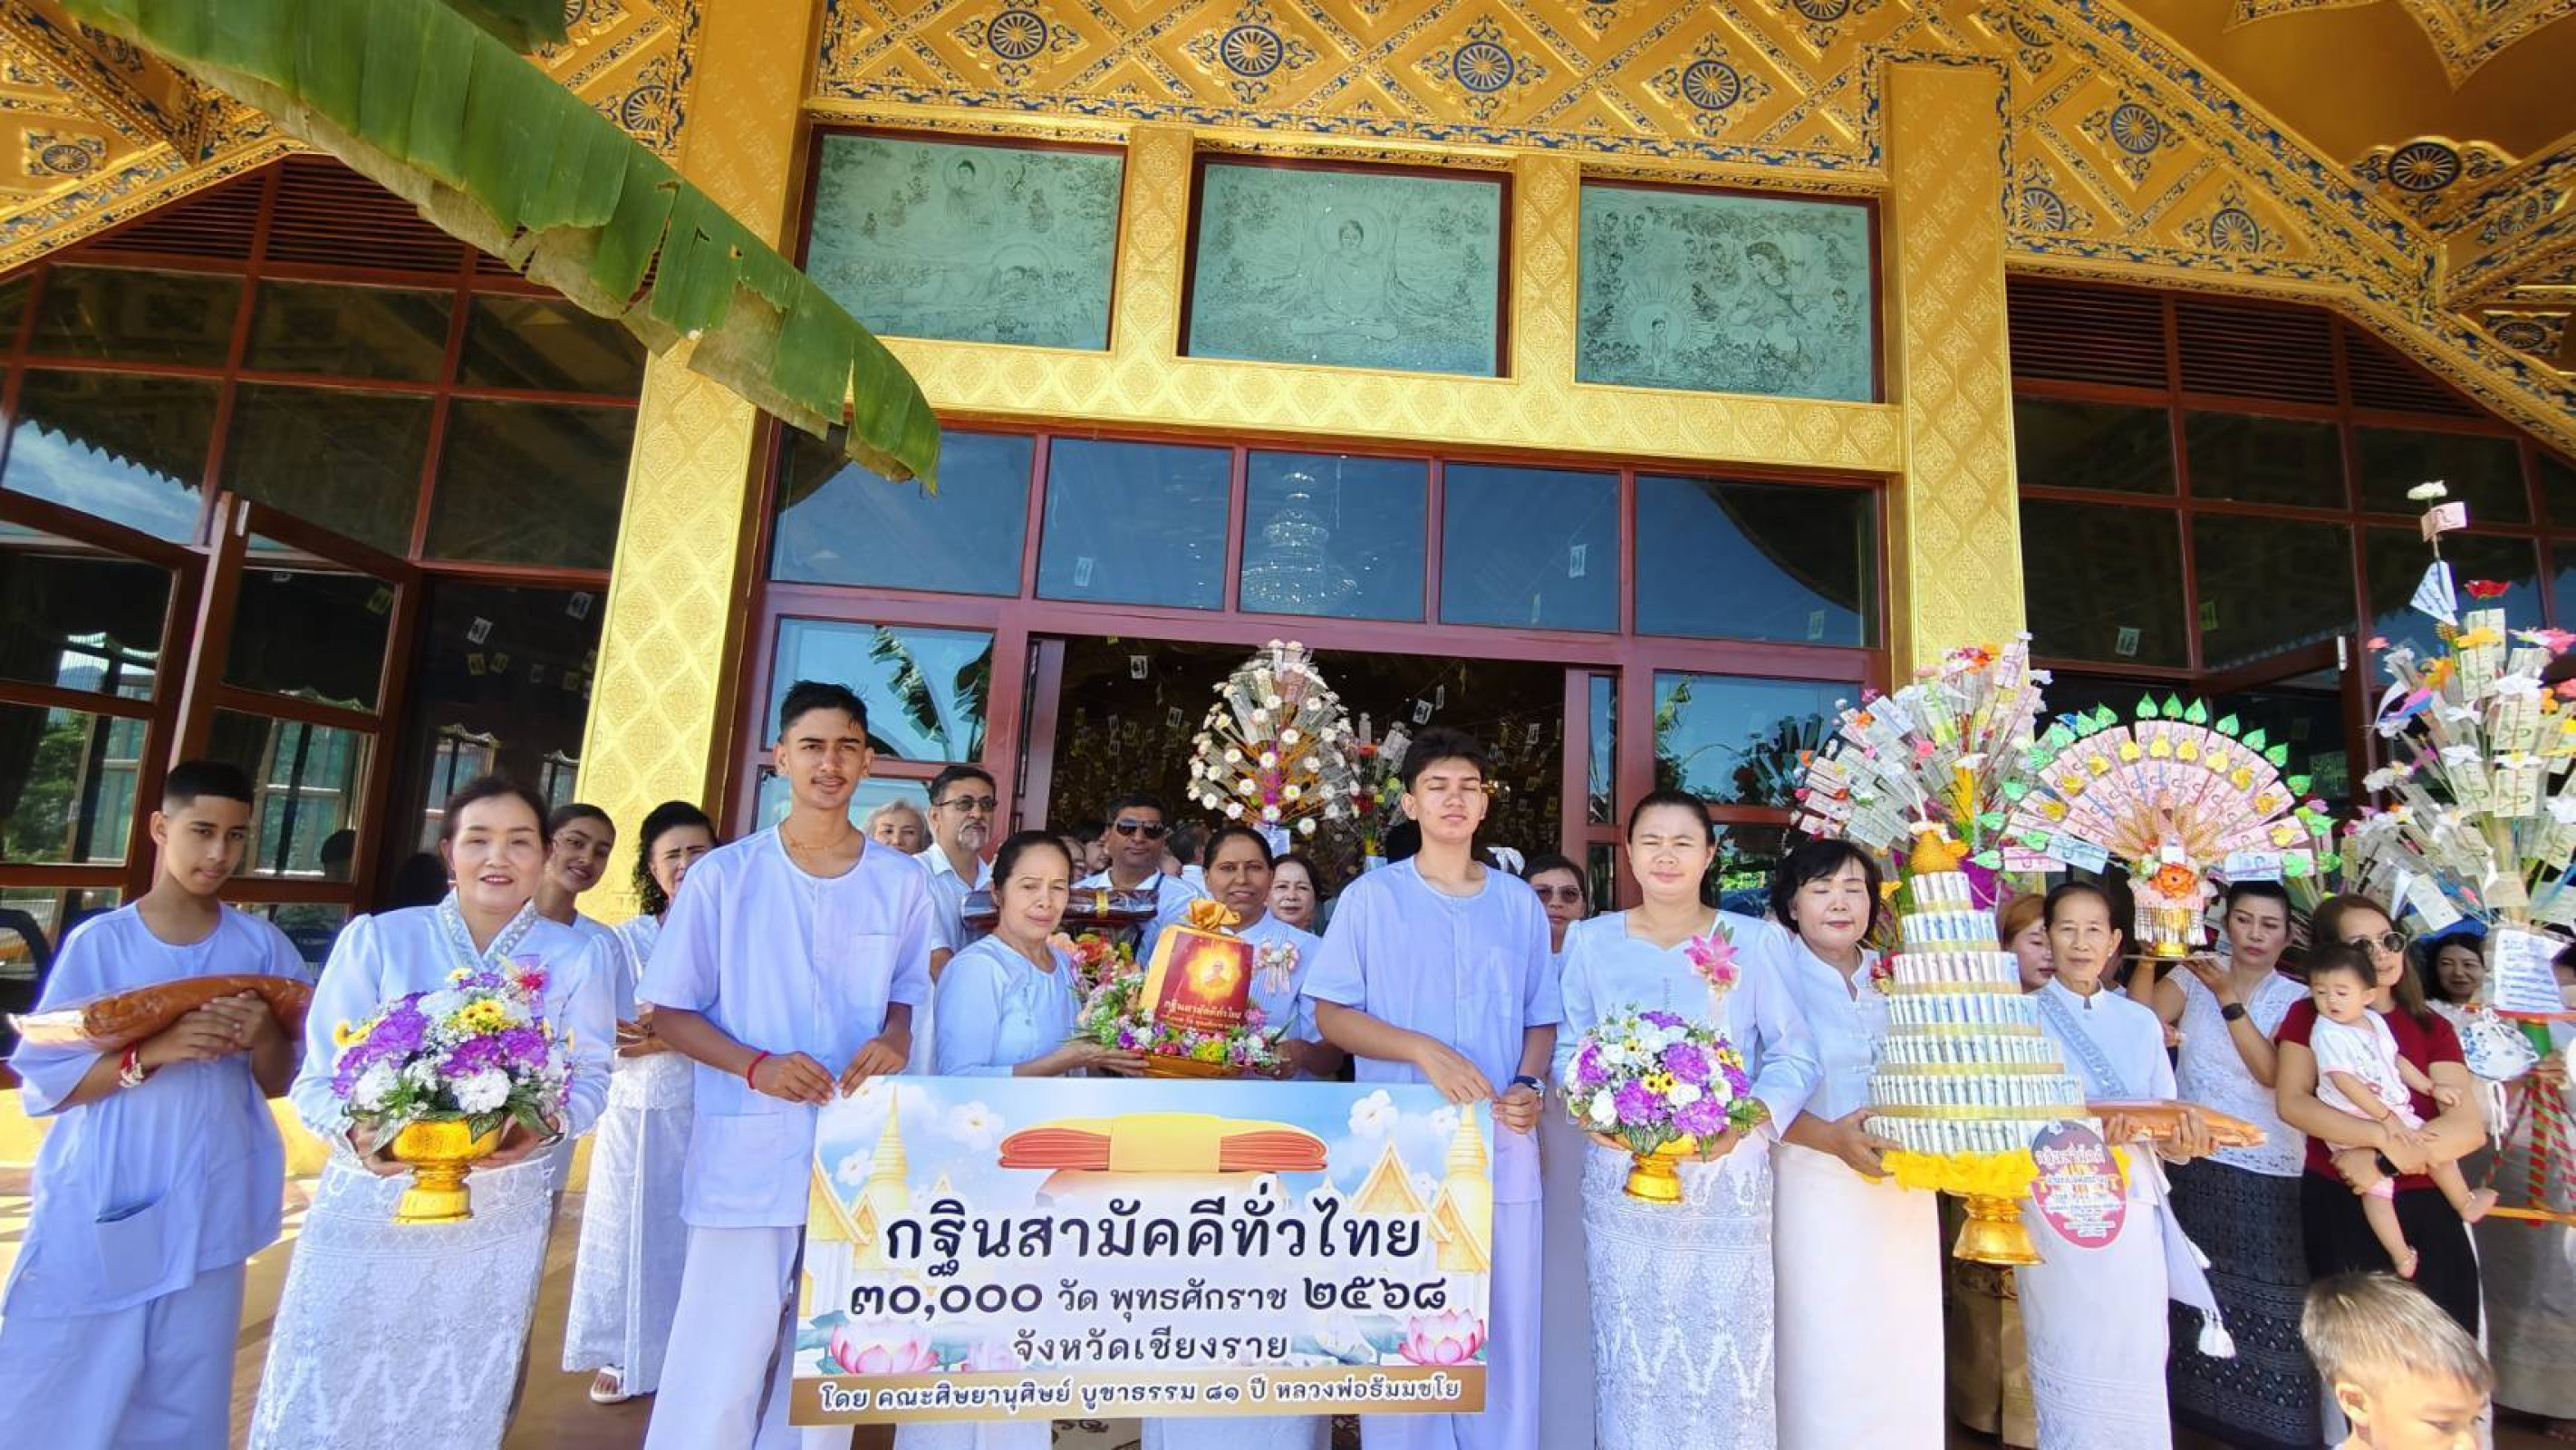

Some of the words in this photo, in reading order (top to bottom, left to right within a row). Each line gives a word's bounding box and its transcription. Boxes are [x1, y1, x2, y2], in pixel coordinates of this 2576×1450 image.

[886, 1182, 1420, 1277] กฐินสามัคคีทั่วไทย
[850, 1283, 1043, 1321] ๓๐,๐๐๐
[1058, 1279, 1098, 1310] วัด
[1110, 1278, 1287, 1323] พุทธศักราช
[1303, 1276, 1446, 1310] ๒๕๖๘
[1014, 1326, 1287, 1361] จังหวัดเชียงราย
[821, 1384, 867, 1408] โดย
[878, 1378, 1072, 1412] คณะศิษยานุศิษย์
[1205, 1385, 1240, 1401] ๘๑
[1249, 1377, 1266, 1400] ปี
